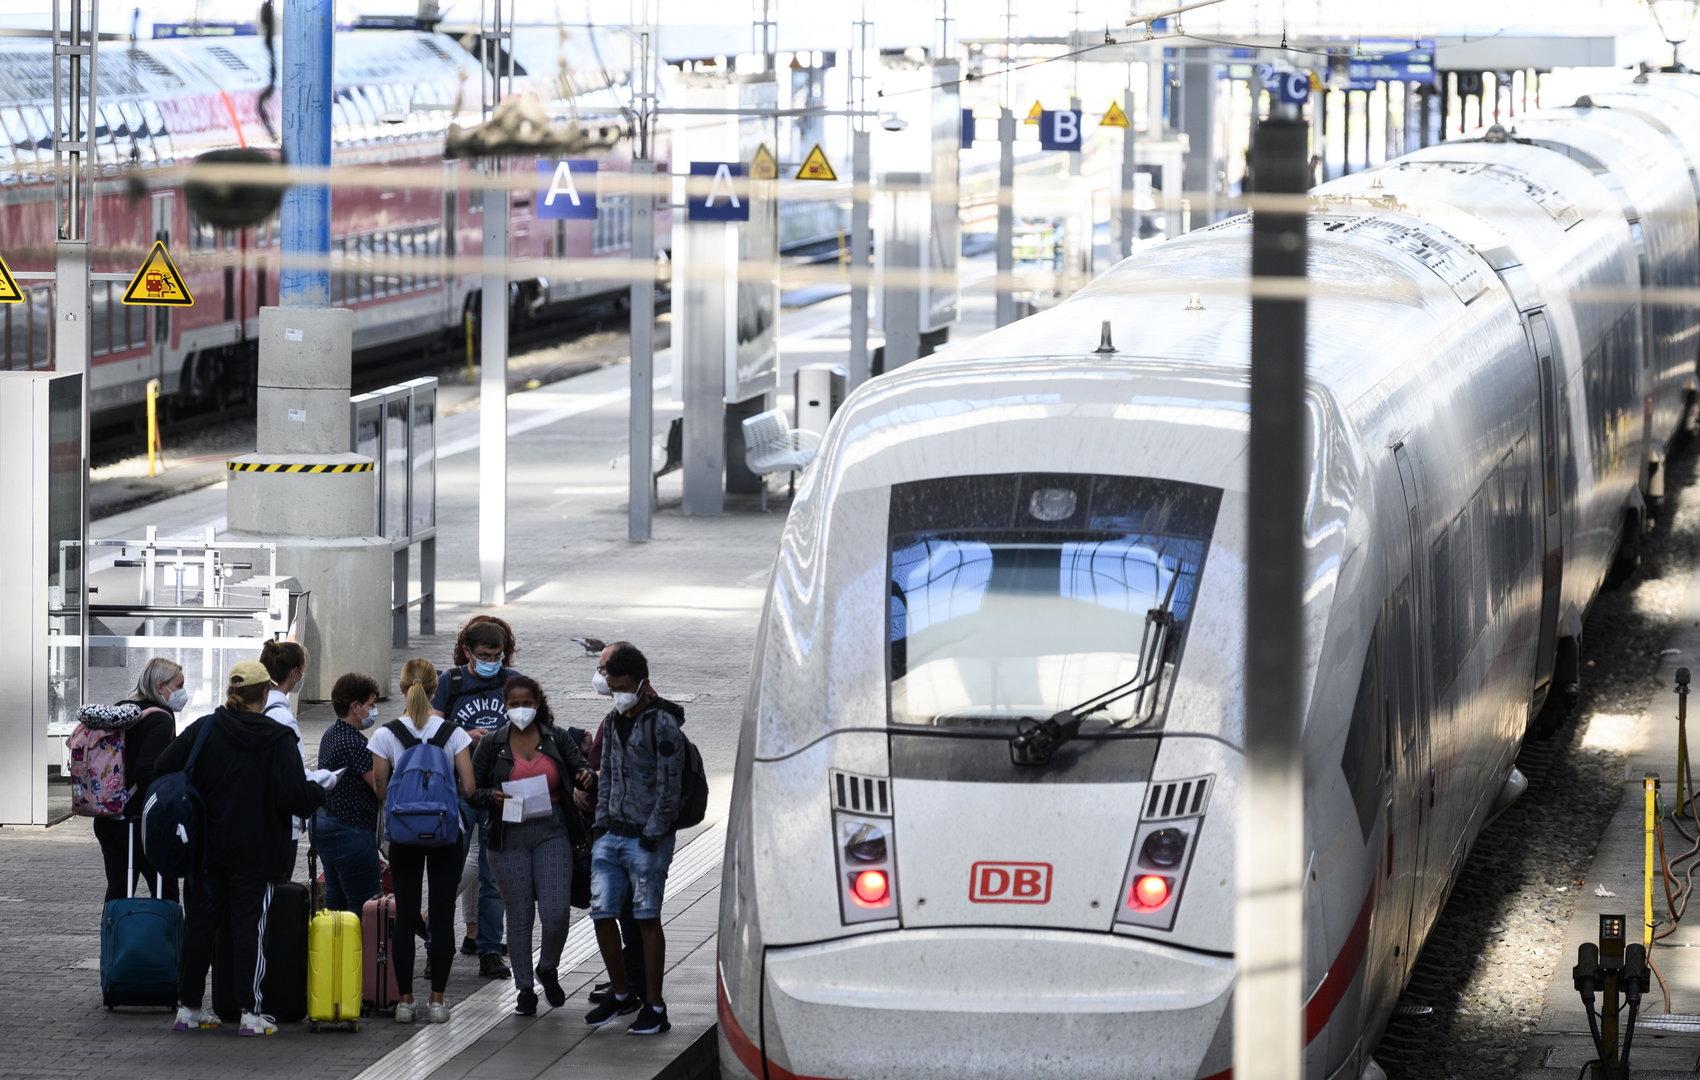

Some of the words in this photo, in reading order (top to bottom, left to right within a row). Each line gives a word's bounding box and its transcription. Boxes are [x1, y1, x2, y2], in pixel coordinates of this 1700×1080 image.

[1287, 71, 1308, 100] C
[1053, 110, 1079, 143] B
[544, 161, 581, 206] A
[704, 163, 741, 208] A
[980, 868, 1042, 897] DB
